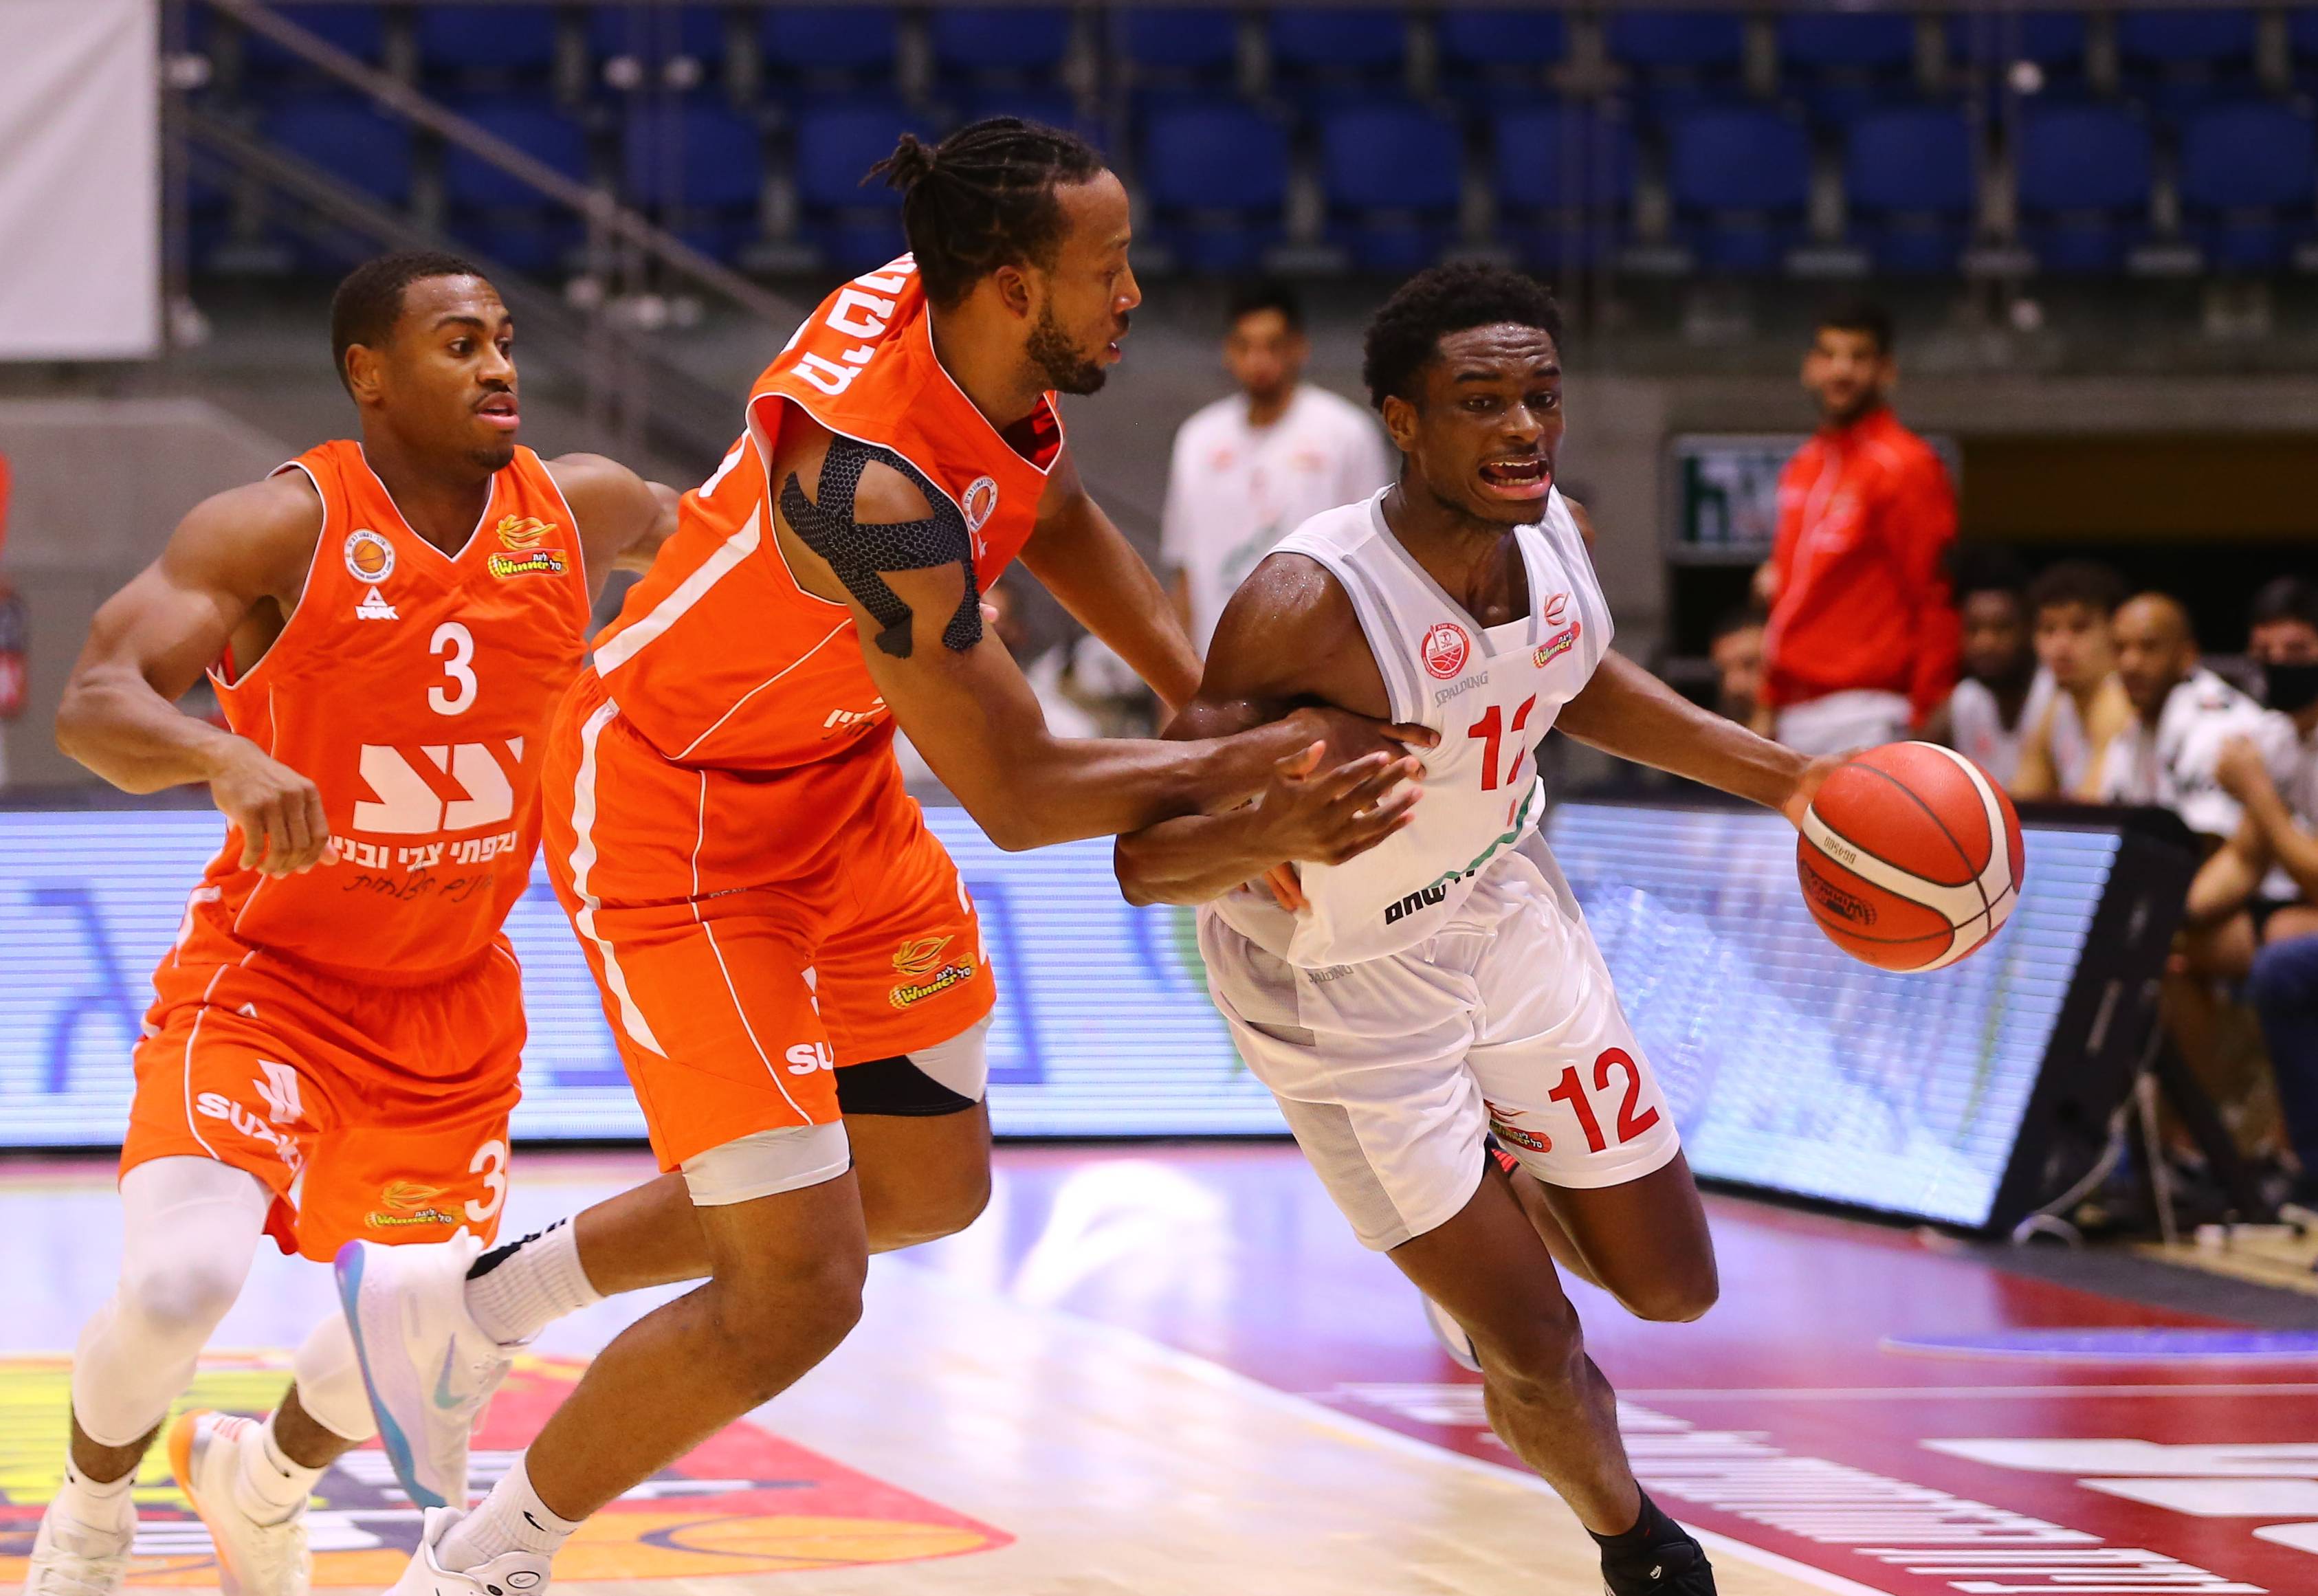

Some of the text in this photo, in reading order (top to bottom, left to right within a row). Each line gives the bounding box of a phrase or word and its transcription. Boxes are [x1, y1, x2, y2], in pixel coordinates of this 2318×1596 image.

[498, 559, 549, 575] Winner
[428, 621, 478, 716] 3
[1539, 640, 1572, 664] Winner
[1435, 671, 1489, 708] SPALDING
[901, 967, 971, 1003] Winner סל
[1547, 1047, 1661, 1153] 12
[464, 1139, 507, 1223] 3
[376, 1215, 437, 1225] Winner
